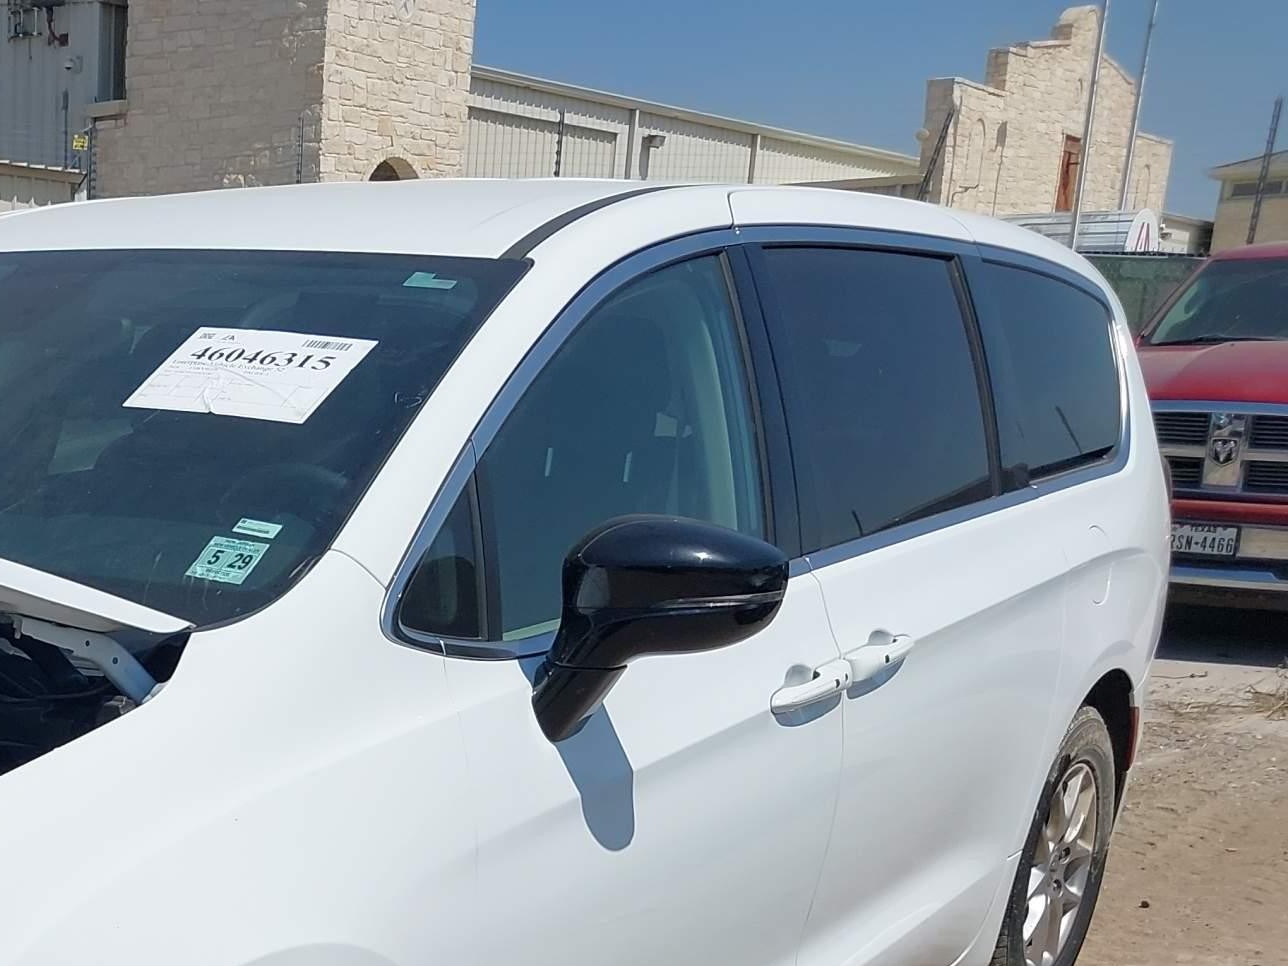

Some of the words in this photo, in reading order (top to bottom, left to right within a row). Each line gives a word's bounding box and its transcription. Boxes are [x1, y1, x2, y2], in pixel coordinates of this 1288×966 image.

[190, 345, 337, 373] 46046315
[207, 550, 225, 565] 5
[227, 553, 254, 570] 29
